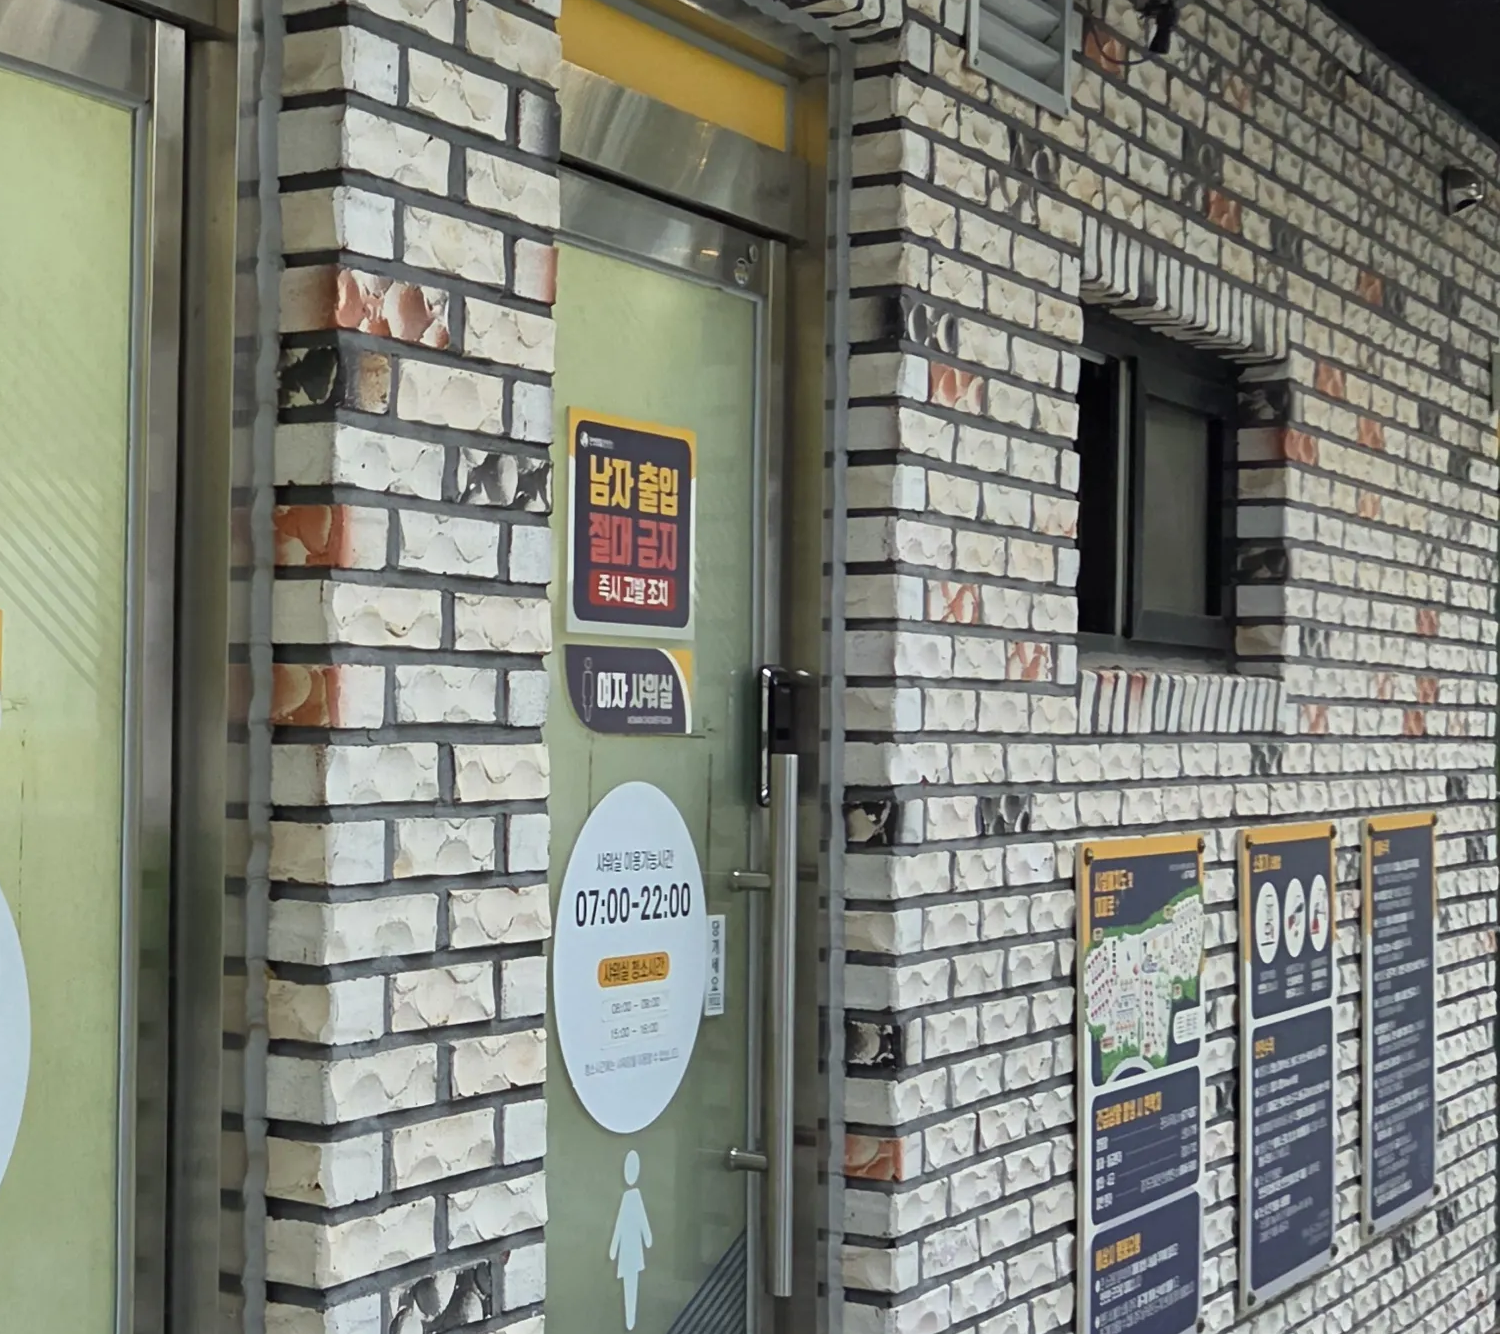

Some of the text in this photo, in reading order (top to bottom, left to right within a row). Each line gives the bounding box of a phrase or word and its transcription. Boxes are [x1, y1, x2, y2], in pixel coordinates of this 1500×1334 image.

[590, 454, 679, 517] 남자 출입
[589, 512, 677, 571] 절대 금지
[598, 574, 621, 603] 즉시
[623, 576, 646, 605] 고발
[597, 672, 673, 710] 여자 샤워실
[596, 852, 622, 873] 샤워실
[575, 882, 691, 927] 07:00-22:00
